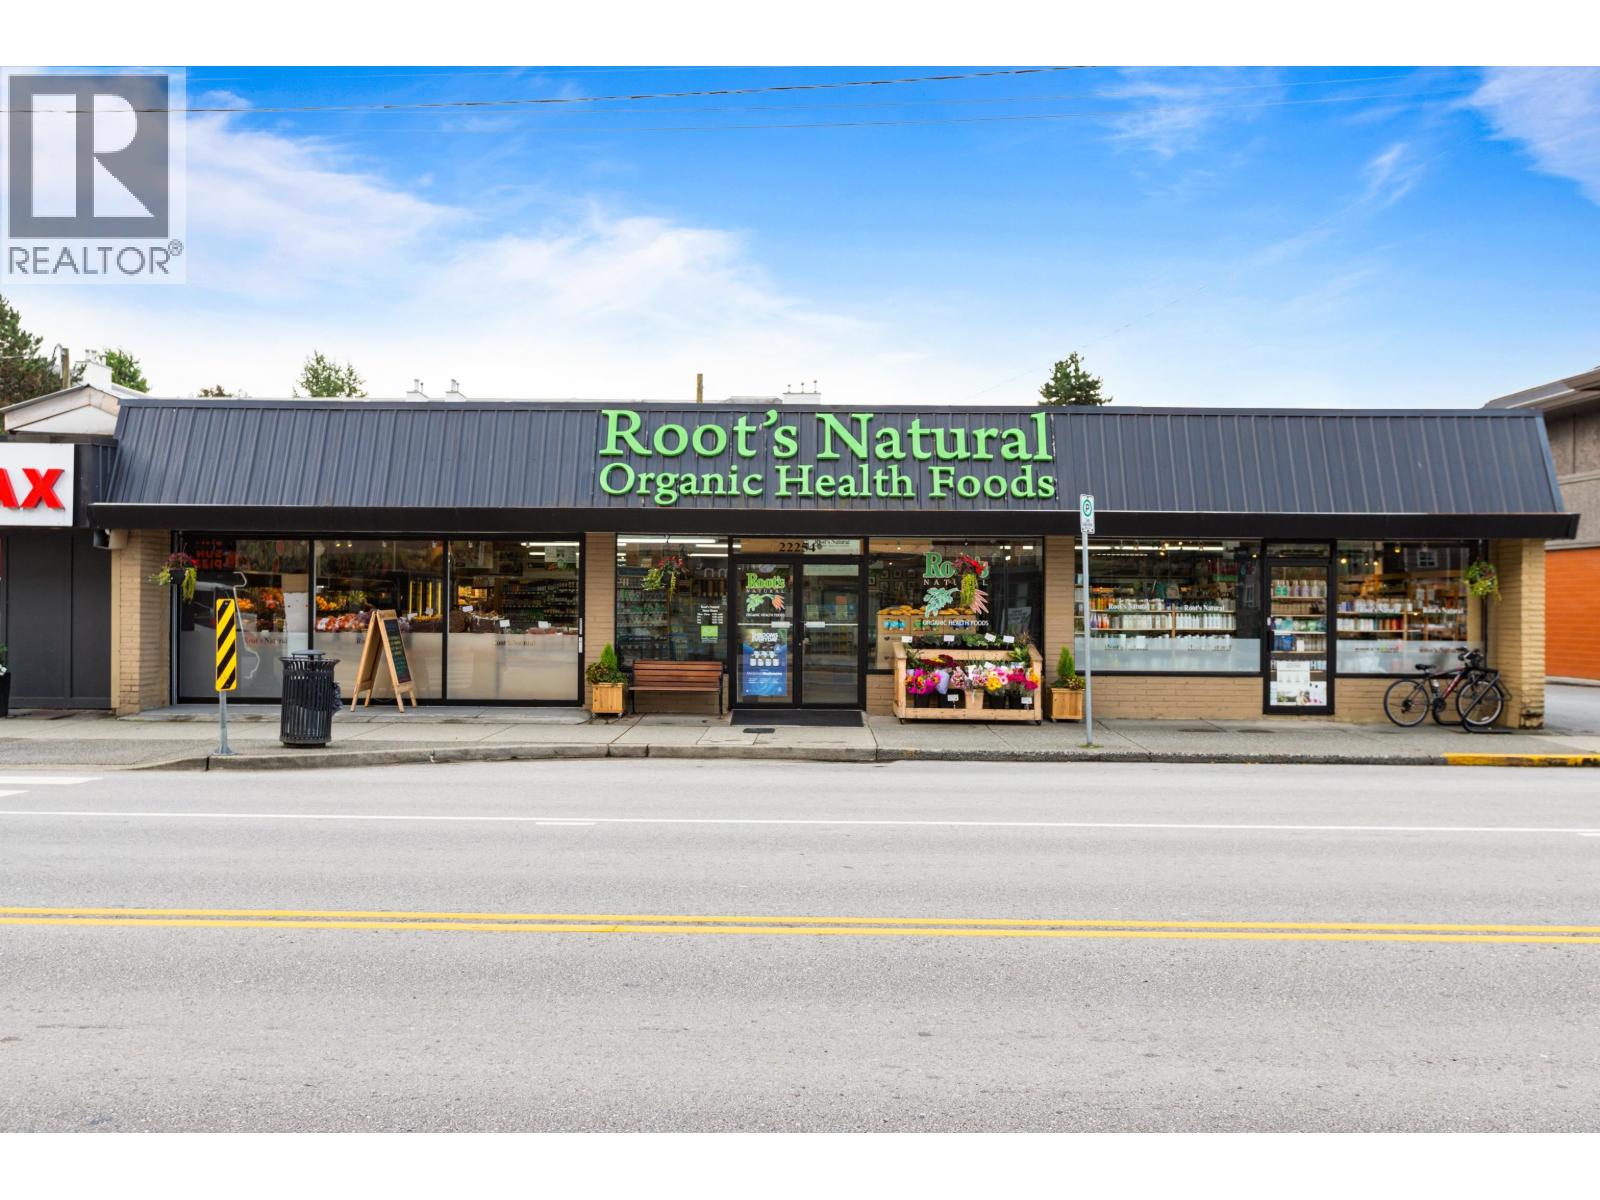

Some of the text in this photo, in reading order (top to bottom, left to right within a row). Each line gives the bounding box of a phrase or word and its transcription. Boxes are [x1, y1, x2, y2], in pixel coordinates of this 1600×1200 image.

[599, 409, 1053, 462] Root's Natural
[599, 462, 1056, 505] Organic Health Foods
[779, 542, 816, 553] 22254
